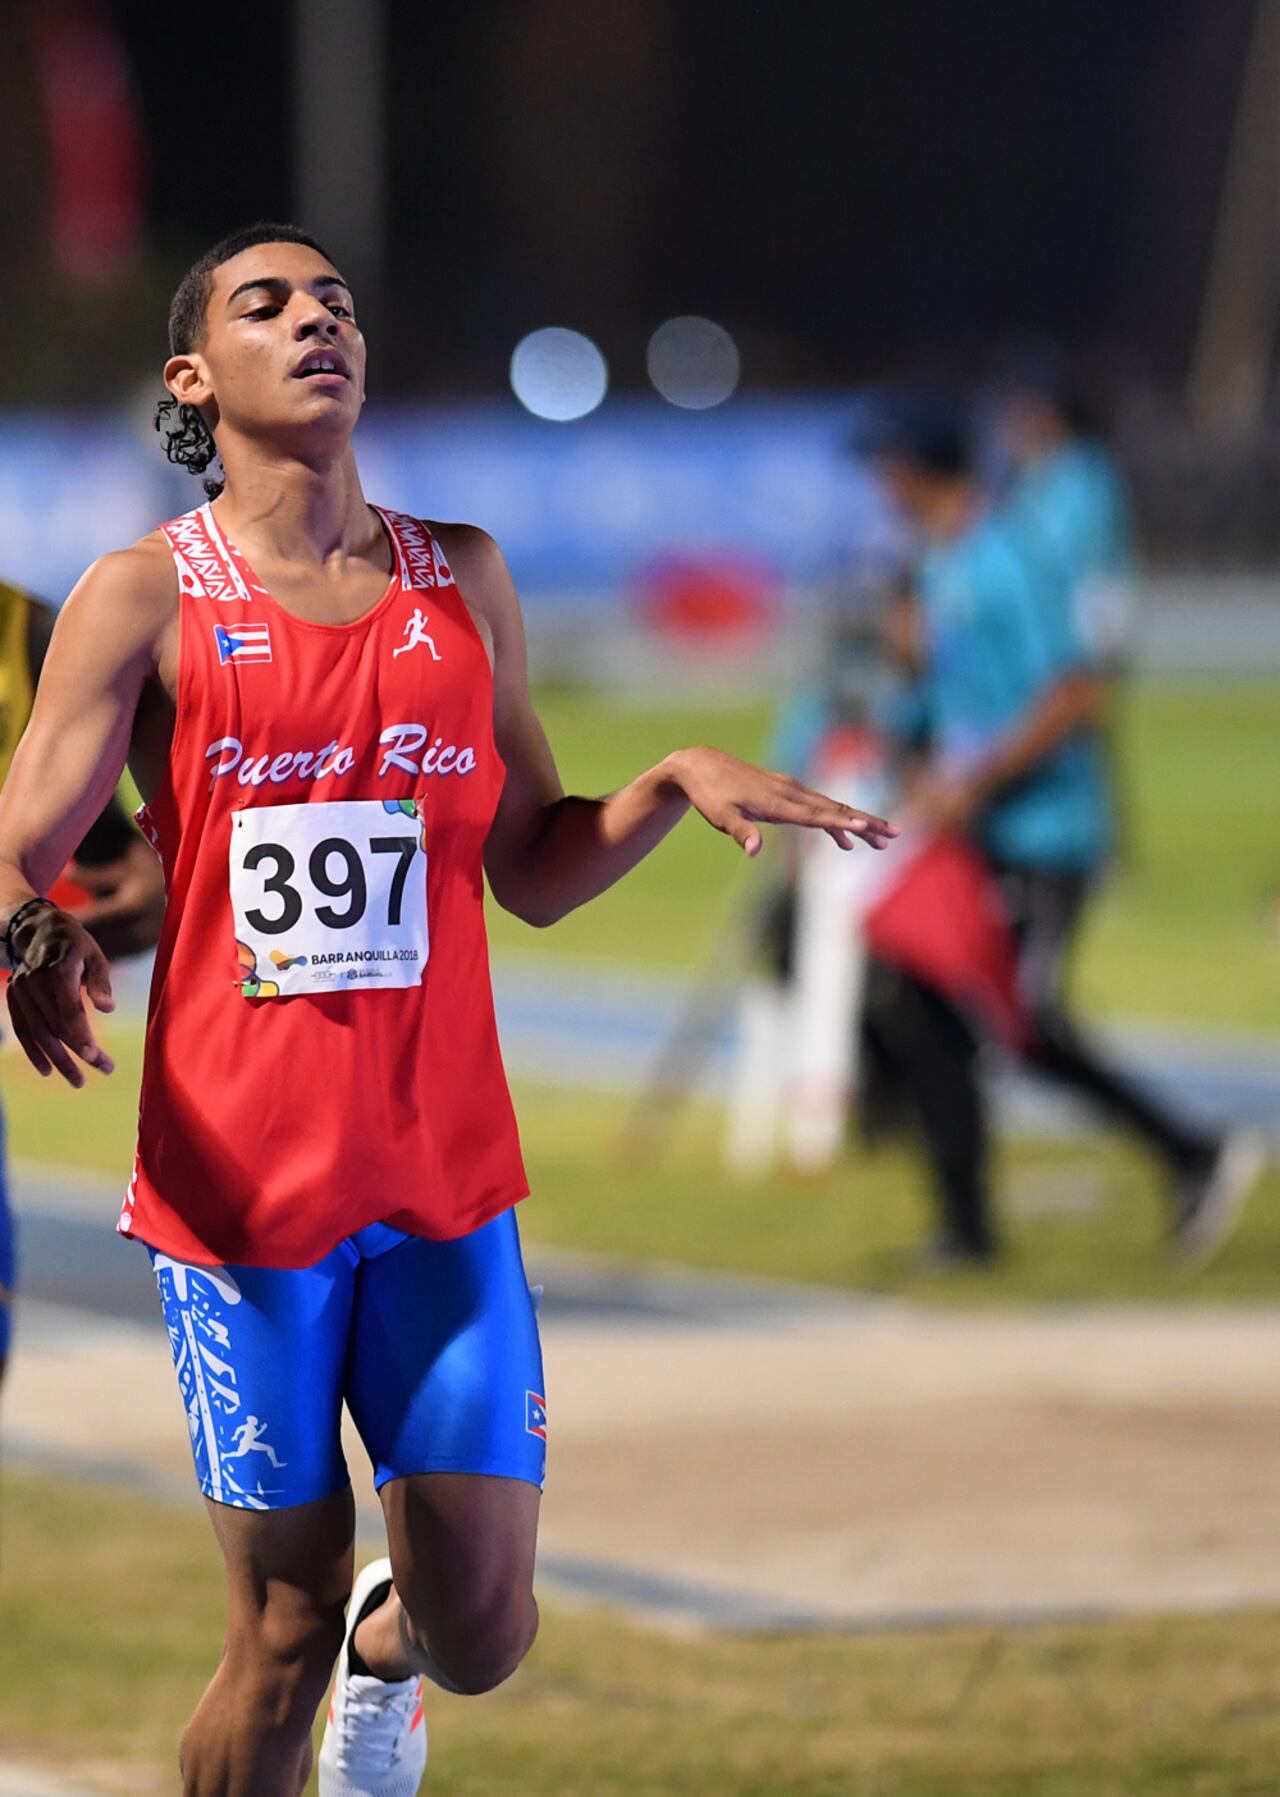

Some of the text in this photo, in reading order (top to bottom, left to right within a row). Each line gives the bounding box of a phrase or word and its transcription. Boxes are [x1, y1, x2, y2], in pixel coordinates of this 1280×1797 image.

[205, 723, 477, 790] Puerto Rico
[242, 836, 418, 935] 397
[311, 950, 399, 966] BARRANQUILLA
